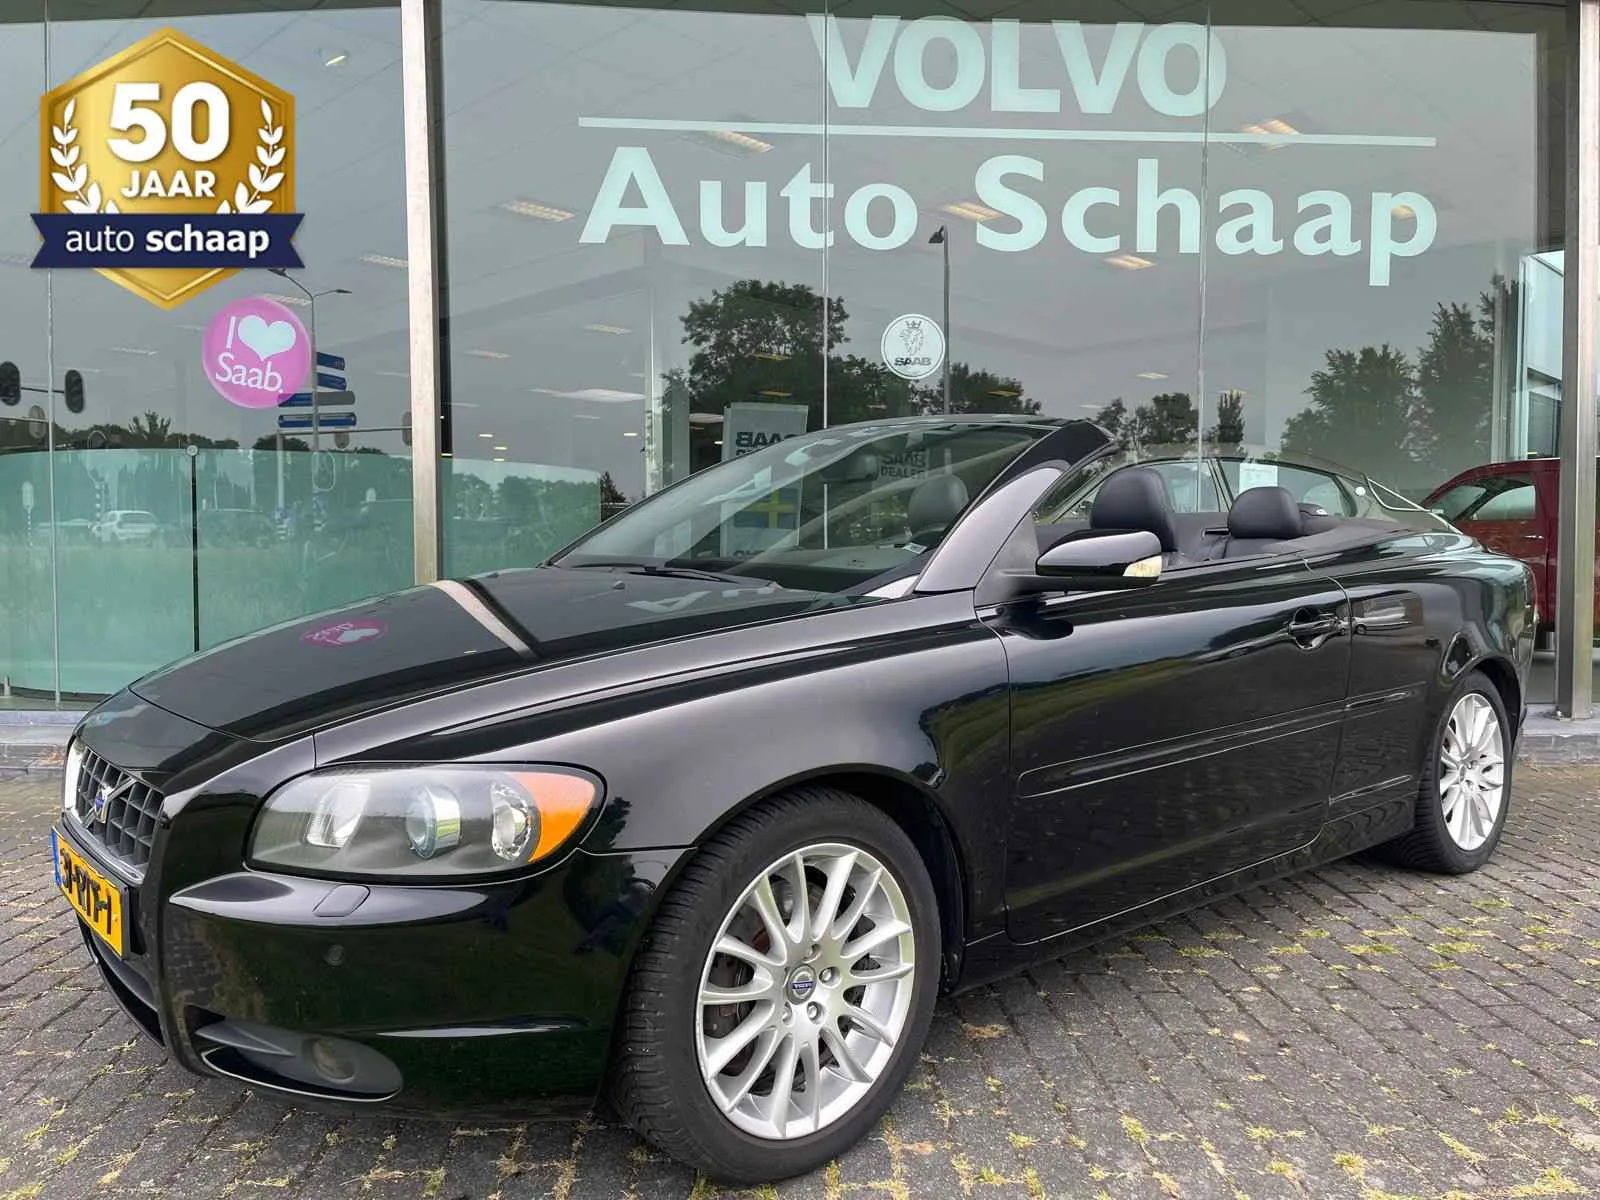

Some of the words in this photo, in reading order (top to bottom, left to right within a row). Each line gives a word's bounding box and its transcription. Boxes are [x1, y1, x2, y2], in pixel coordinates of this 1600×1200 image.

[806, 13, 1227, 117] VOLVO
[579, 146, 919, 251] Auto
[975, 154, 1438, 287] Schaap
[226, 315, 237, 349] I
[894, 356, 932, 367] SAAB
